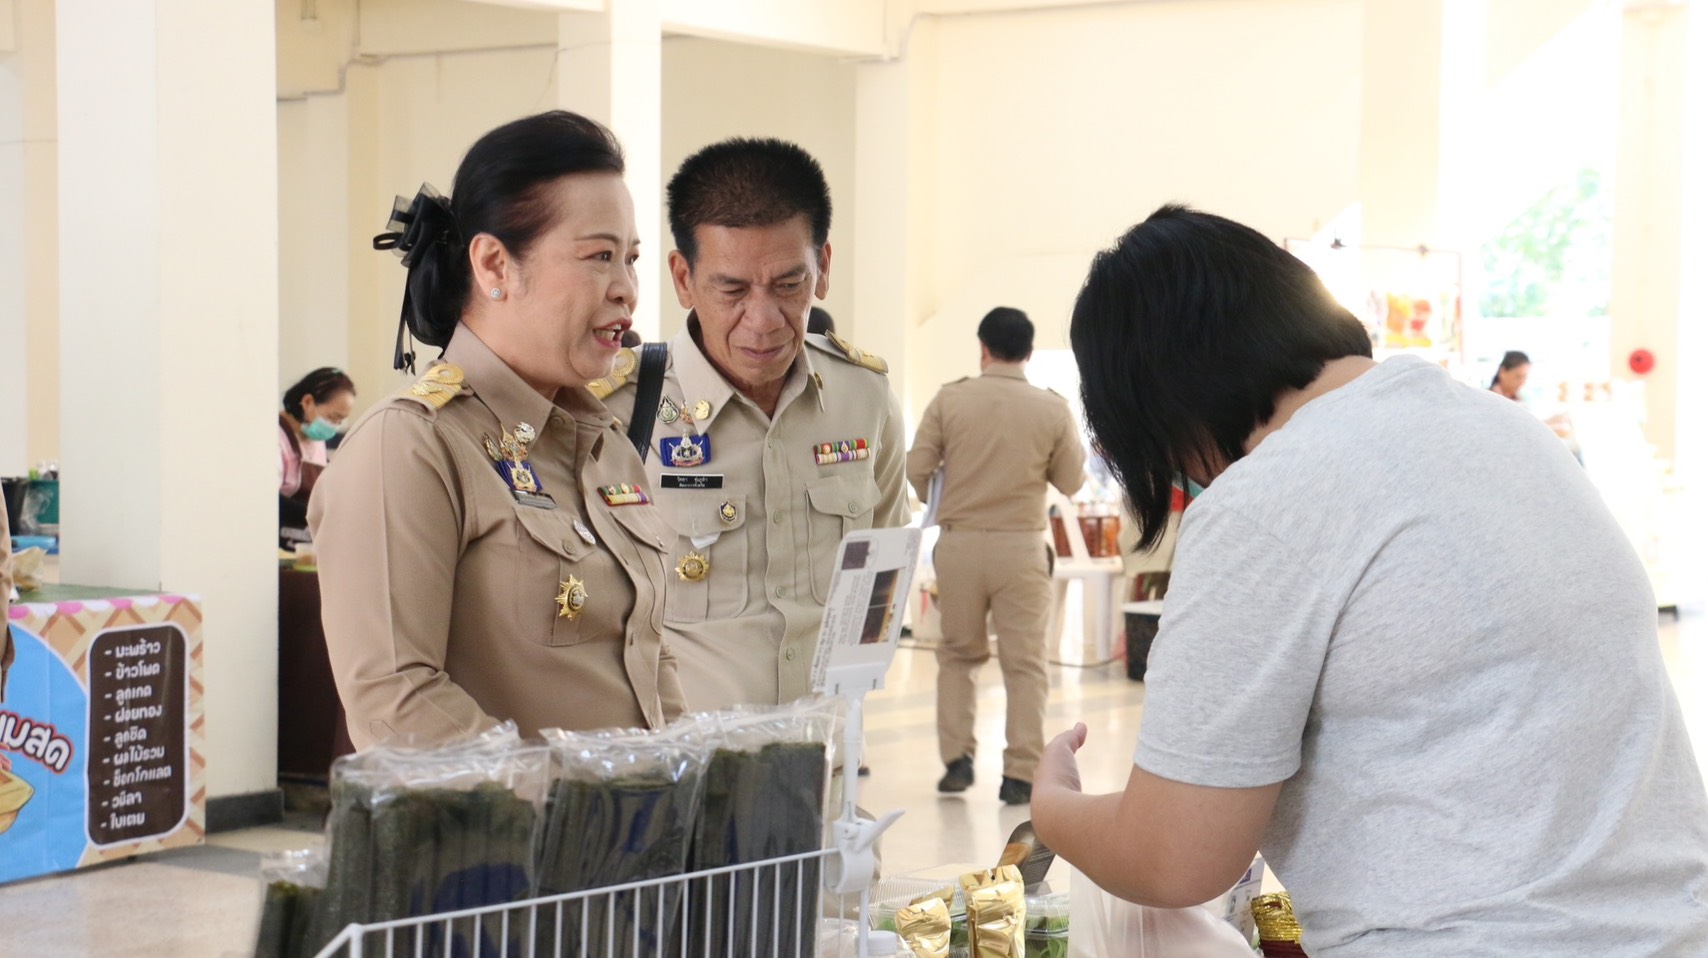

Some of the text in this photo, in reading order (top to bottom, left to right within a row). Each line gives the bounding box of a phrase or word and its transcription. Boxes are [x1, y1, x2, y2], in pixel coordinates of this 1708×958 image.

[115, 638, 161, 658] มะพร้าว
[115, 660, 160, 680] ข้าวโพด
[115, 685, 152, 706] ลูกเกด
[115, 704, 162, 723] ฝอยทอง
[0, 712, 71, 771] มสด
[114, 725, 147, 749] ลูกชิด
[113, 744, 165, 766] ผลไม้รวม
[110, 812, 145, 830] ใบเตย
